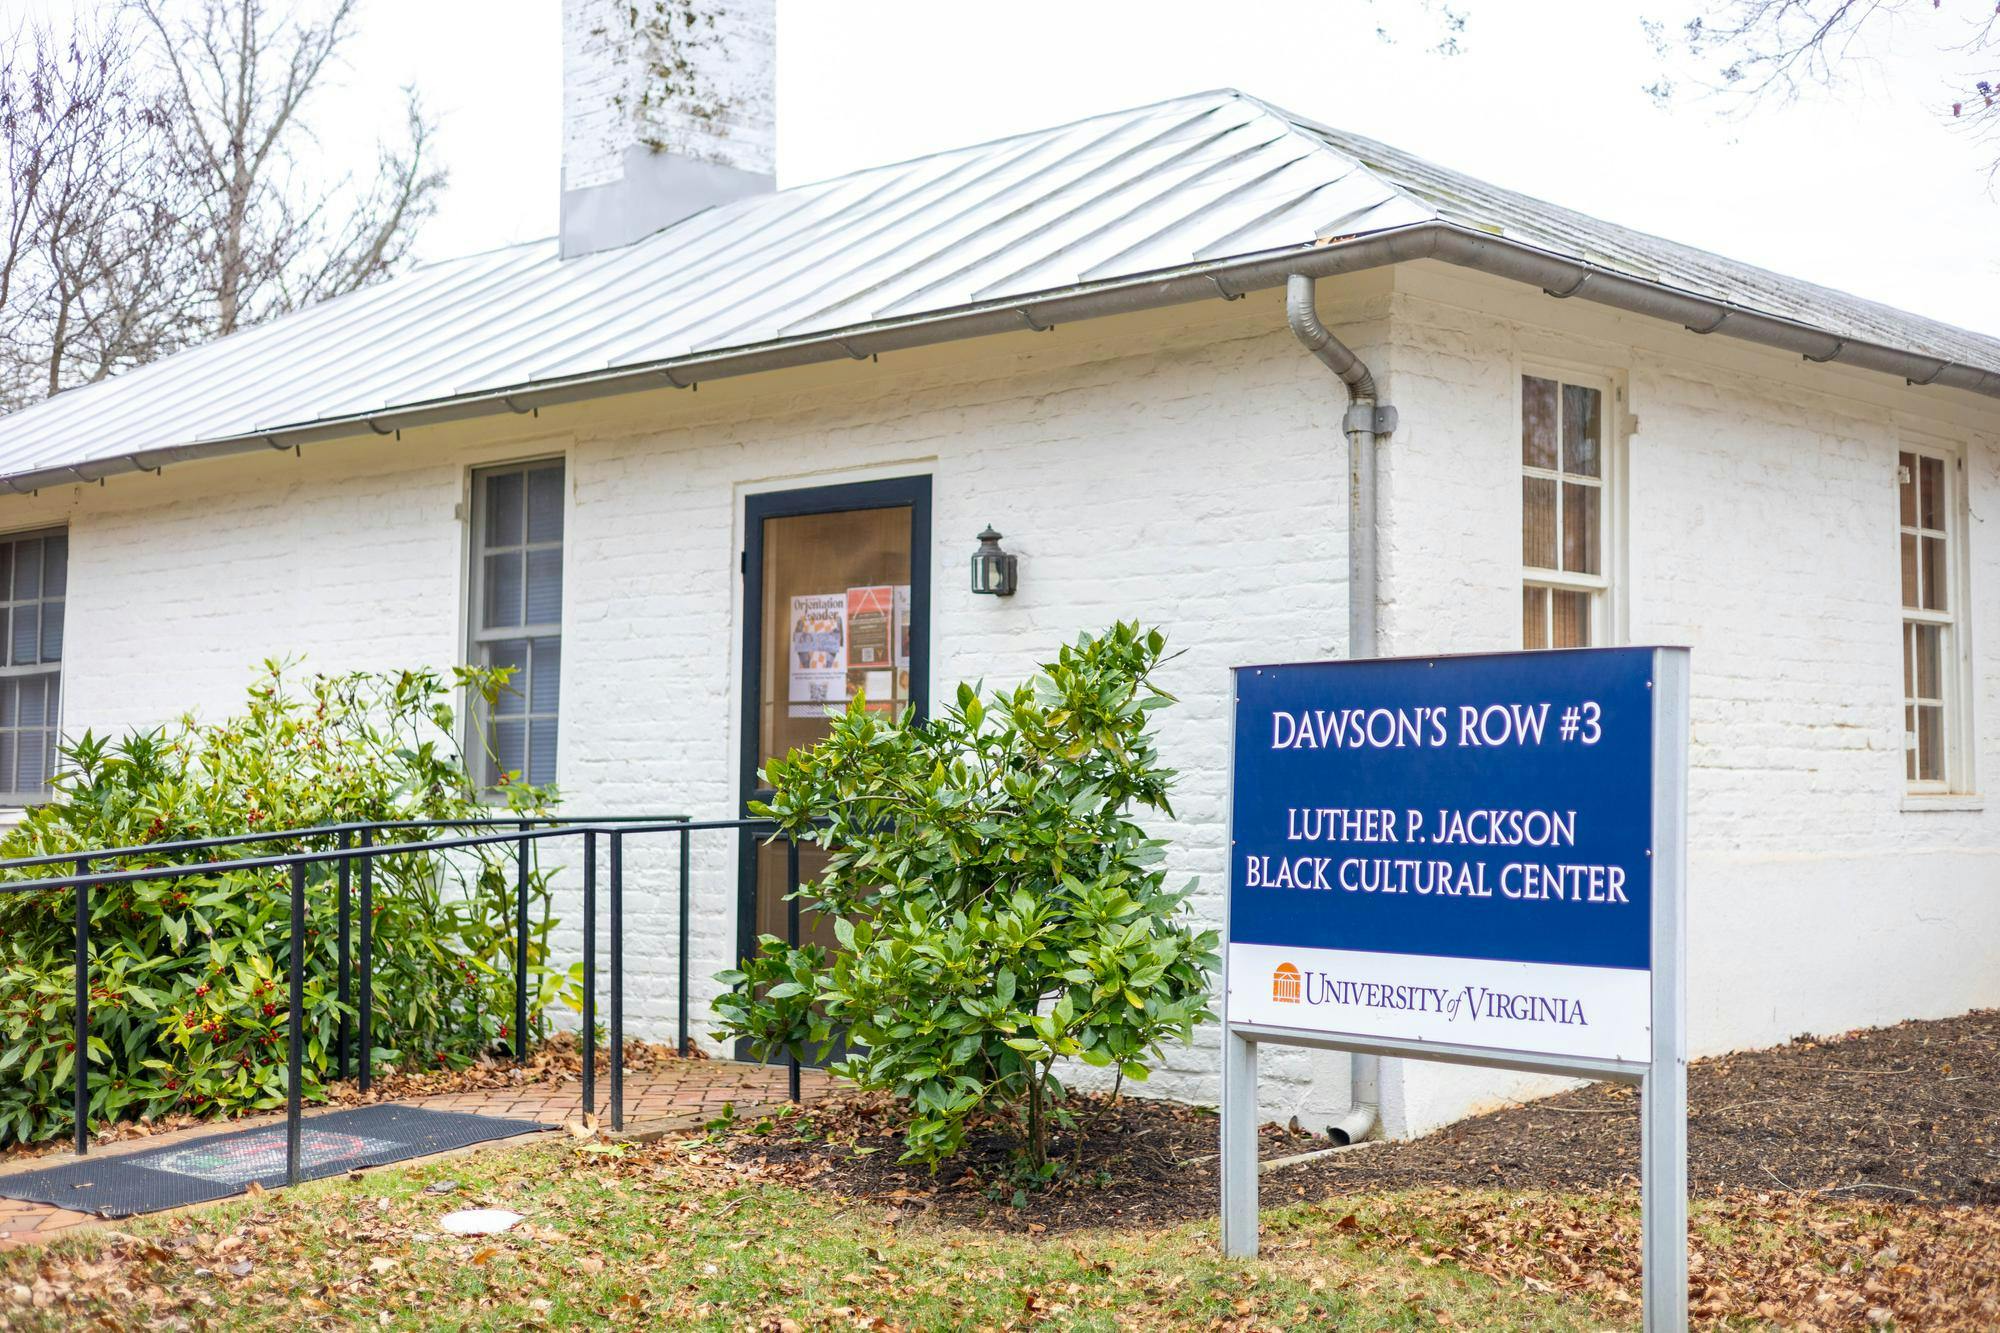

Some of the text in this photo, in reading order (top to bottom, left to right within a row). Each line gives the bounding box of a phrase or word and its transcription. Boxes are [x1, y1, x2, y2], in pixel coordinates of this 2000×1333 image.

[794, 597, 844, 614] Orientation
[1272, 702, 1601, 748] DAWSON'S ROW #3
[1288, 809, 1576, 845] LUTHER P. JACKSON
[1246, 856, 1629, 902] BLACK CULTURAL CENTER
[1305, 972, 1587, 1025] UNIVERSITY of VIRGINIA
